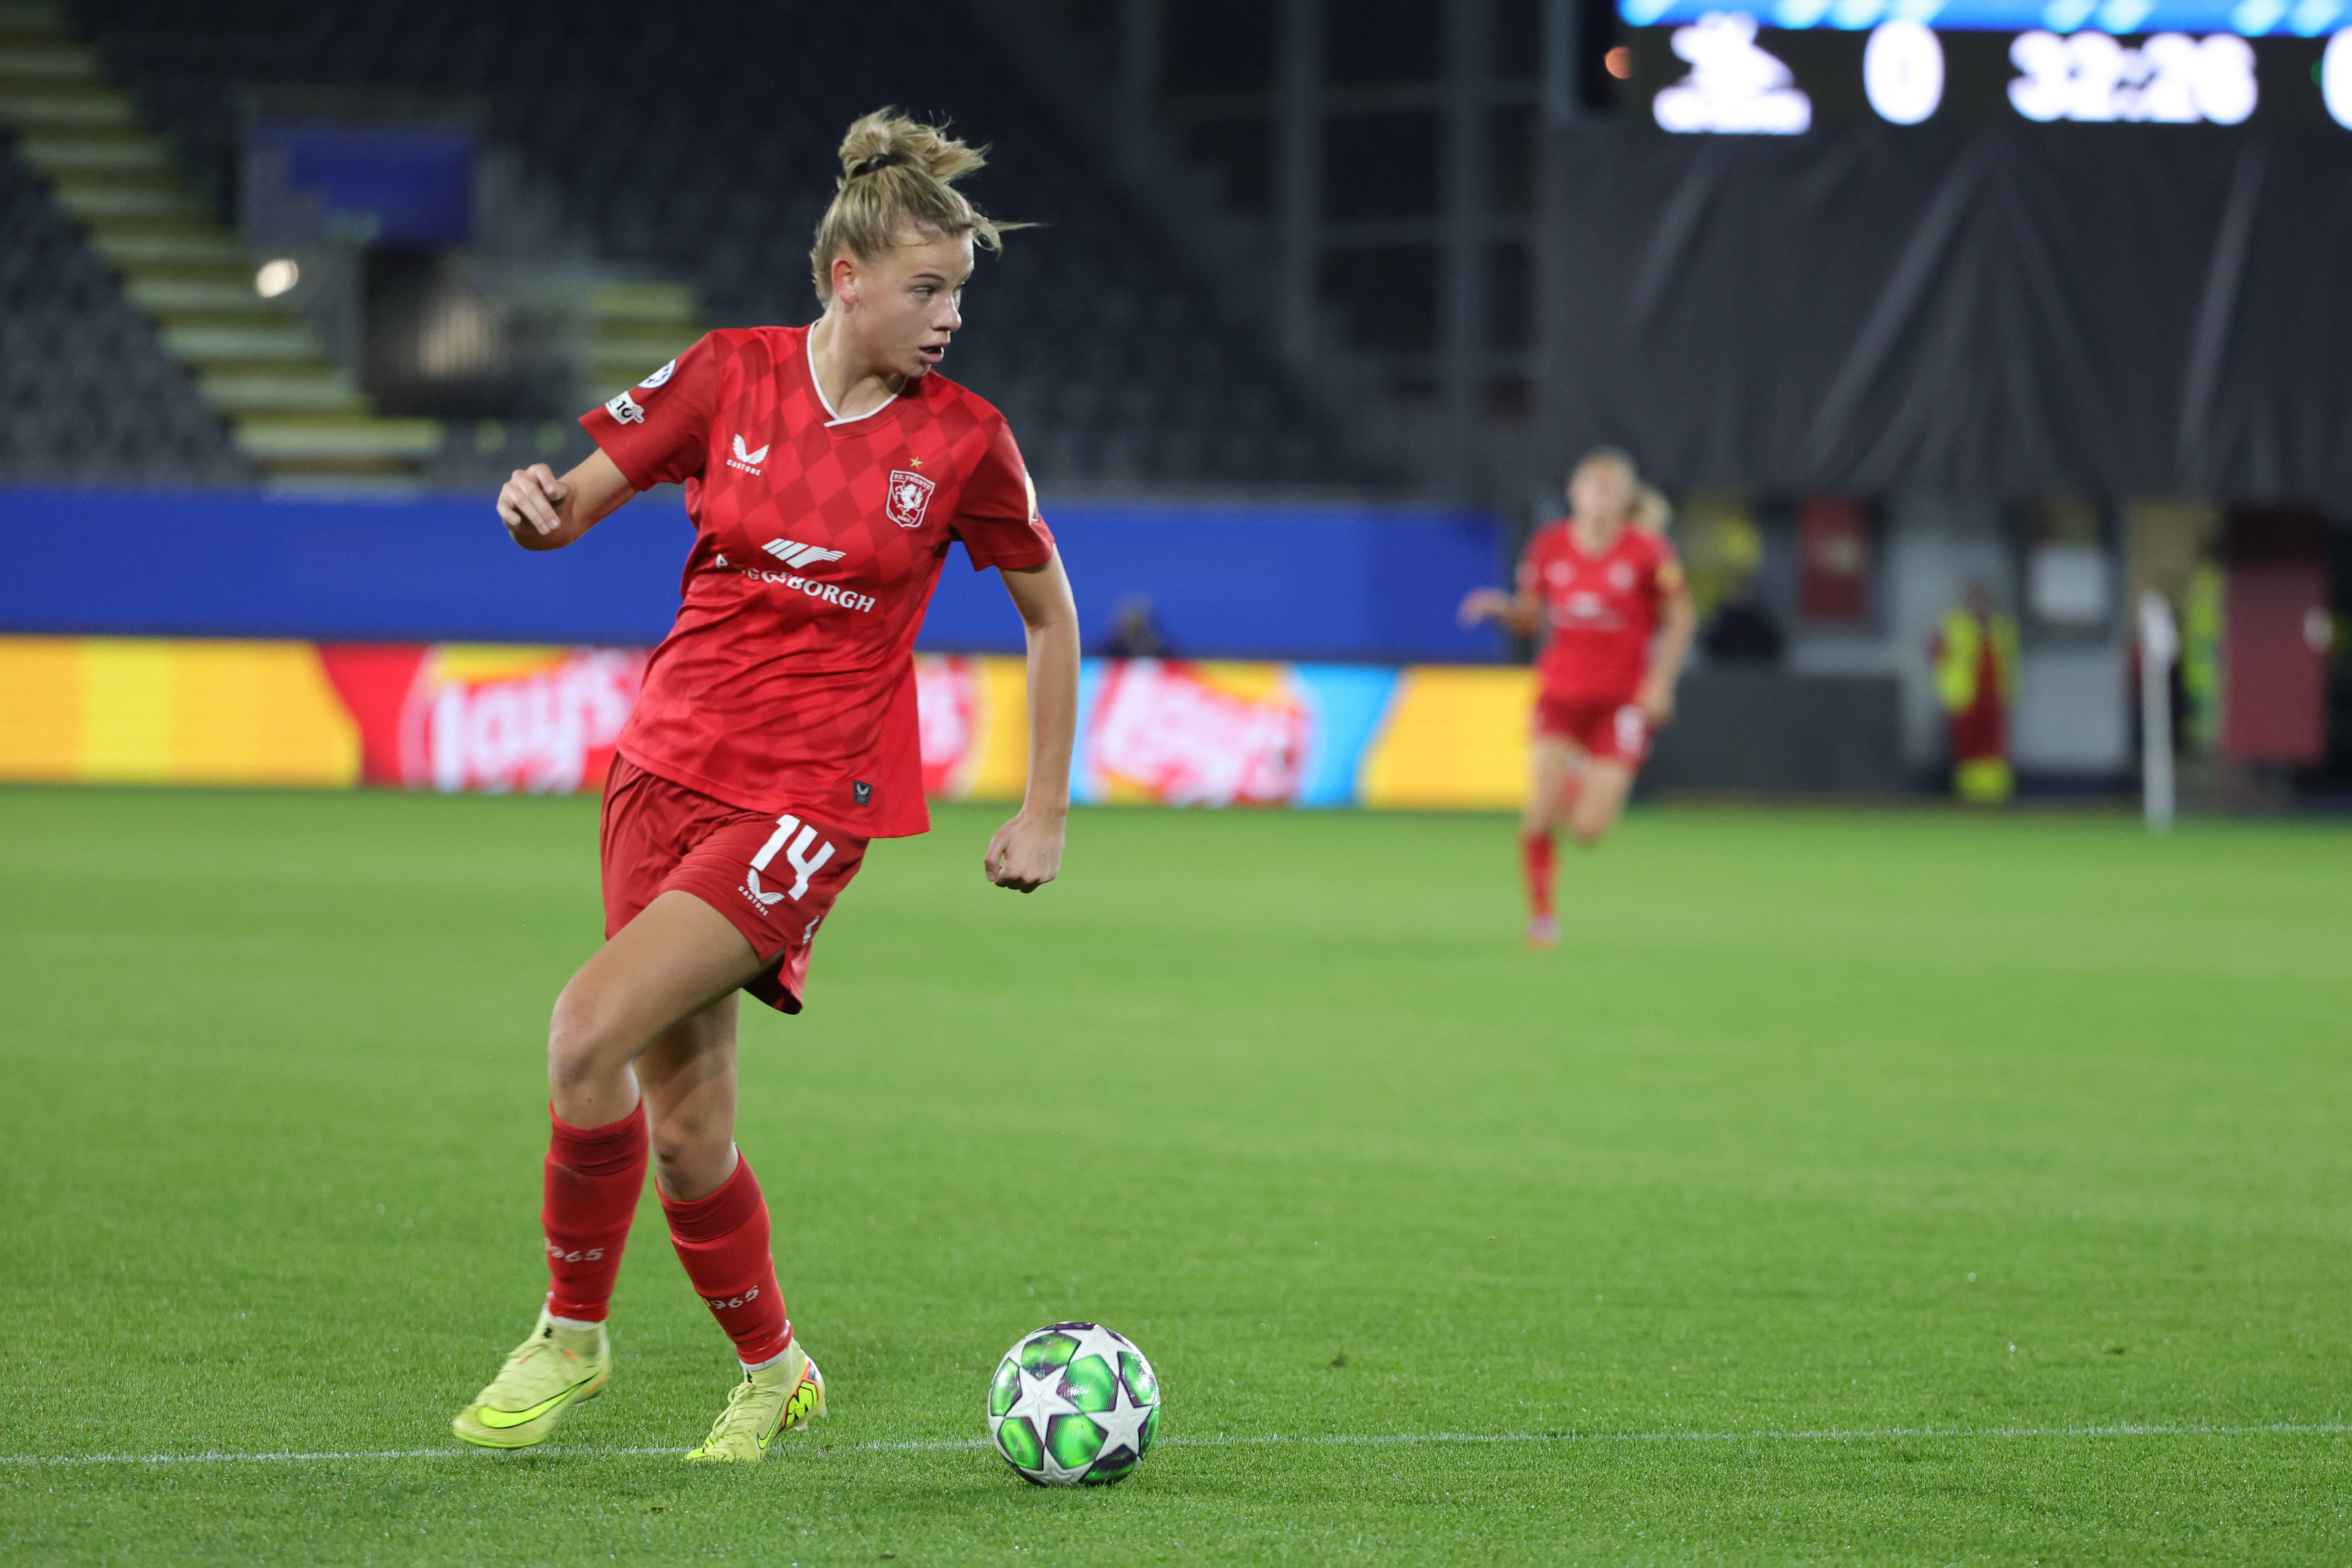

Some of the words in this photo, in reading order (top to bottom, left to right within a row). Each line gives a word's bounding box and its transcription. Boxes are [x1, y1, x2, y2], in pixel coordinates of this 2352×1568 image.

[726, 459, 762, 476] CASTORE
[749, 814, 836, 901] 14
[738, 886, 769, 916] CASTORE
